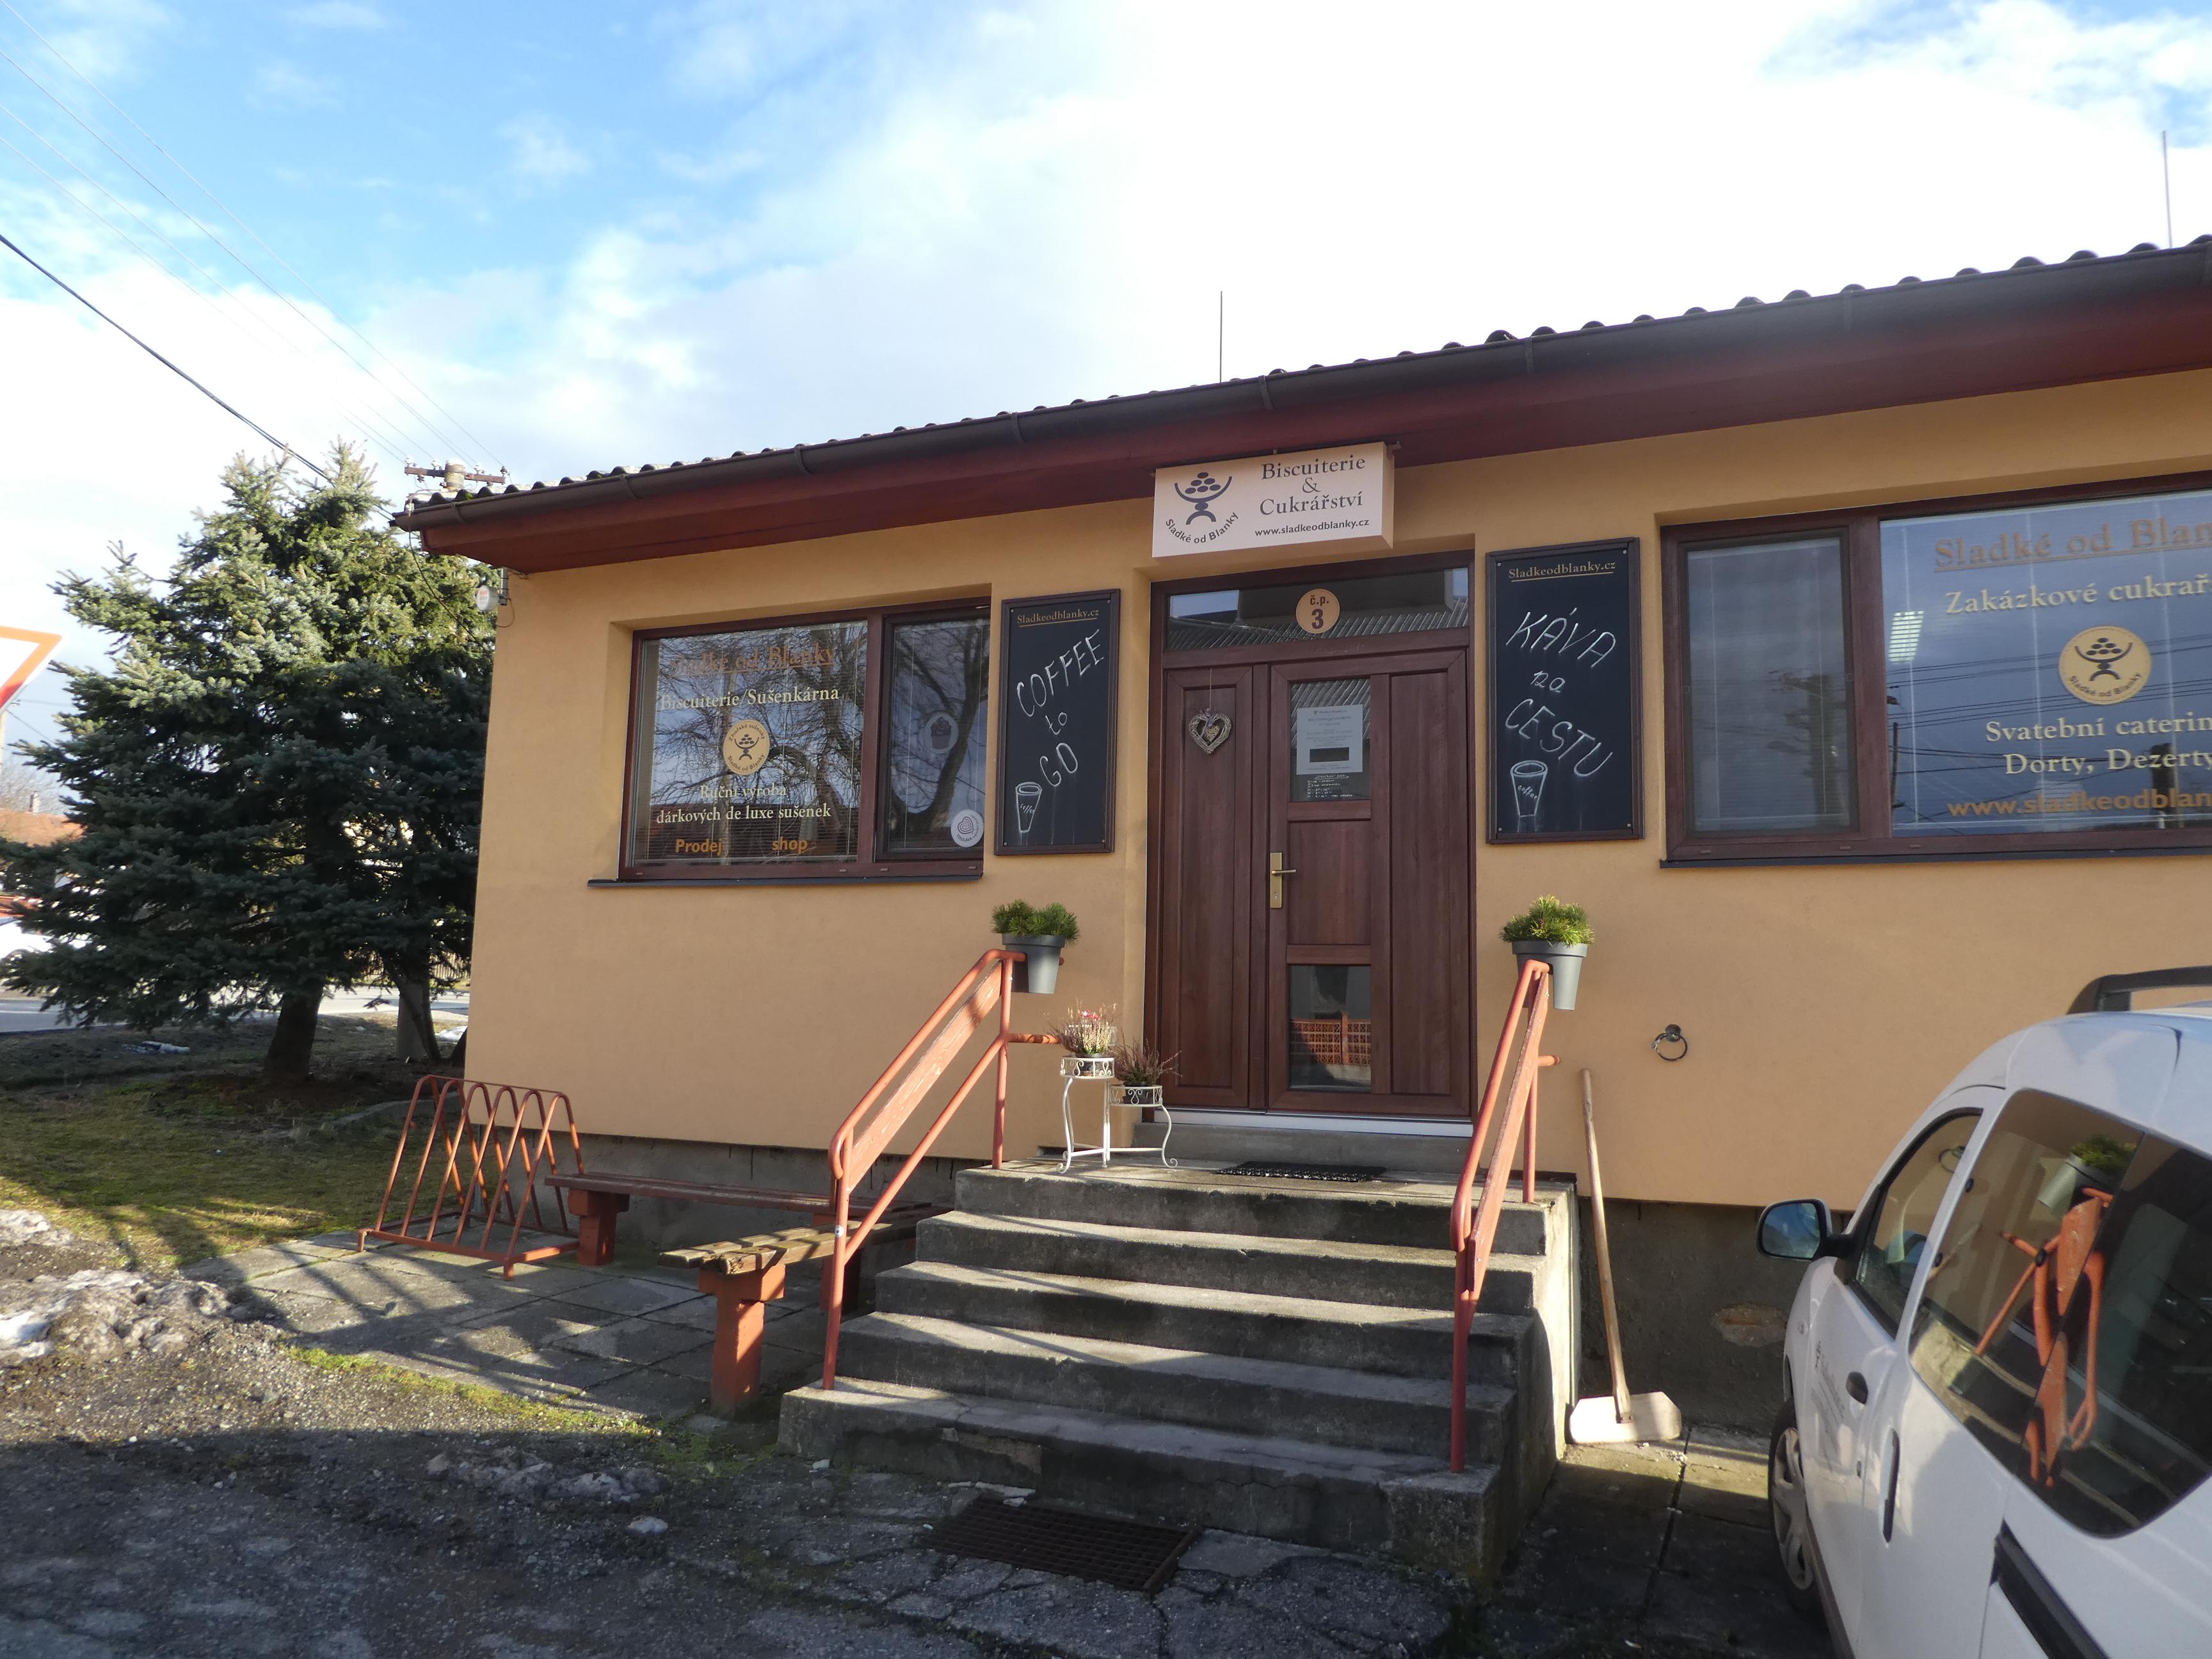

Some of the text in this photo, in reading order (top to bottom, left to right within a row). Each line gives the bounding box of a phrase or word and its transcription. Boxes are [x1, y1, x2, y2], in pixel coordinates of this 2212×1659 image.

[1261, 454, 1366, 480] Biscuiterie
[1302, 477, 1320, 493] &
[1260, 491, 1363, 516] Cukrářství
[1166, 512, 1238, 543] Sladké od Blanky
[1254, 518, 1370, 536] www.sladkeodblanky.cz
[1934, 530, 2053, 567] Sladké
[2067, 522, 2113, 554] od
[1509, 560, 1616, 579] Sladkeodblanky.cz
[1310, 595, 1329, 606] č.p.
[1945, 573, 2212, 615] Zakázkové cukrař
[1016, 609, 1100, 624] Sladkeodblanky.cz
[1311, 609, 1324, 629] 3
[1506, 607, 1616, 668] KÁVA
[768, 641, 834, 666] Blanky
[1016, 629, 1105, 717] COFFEE
[2113, 673, 2142, 694] Blanky
[661, 685, 839, 710] Biscuiterie/Sušenkárna
[1045, 712, 1068, 735] to
[1985, 717, 2105, 742] Svatební
[1505, 698, 1613, 777] CESTU
[1039, 742, 1079, 787] GO
[2004, 748, 2212, 775] Dorty, Dezerty
[1518, 785, 1537, 799] coffee
[656, 803, 832, 824] dárkových de luxe sušenek
[675, 837, 808, 856] Prodej shop
